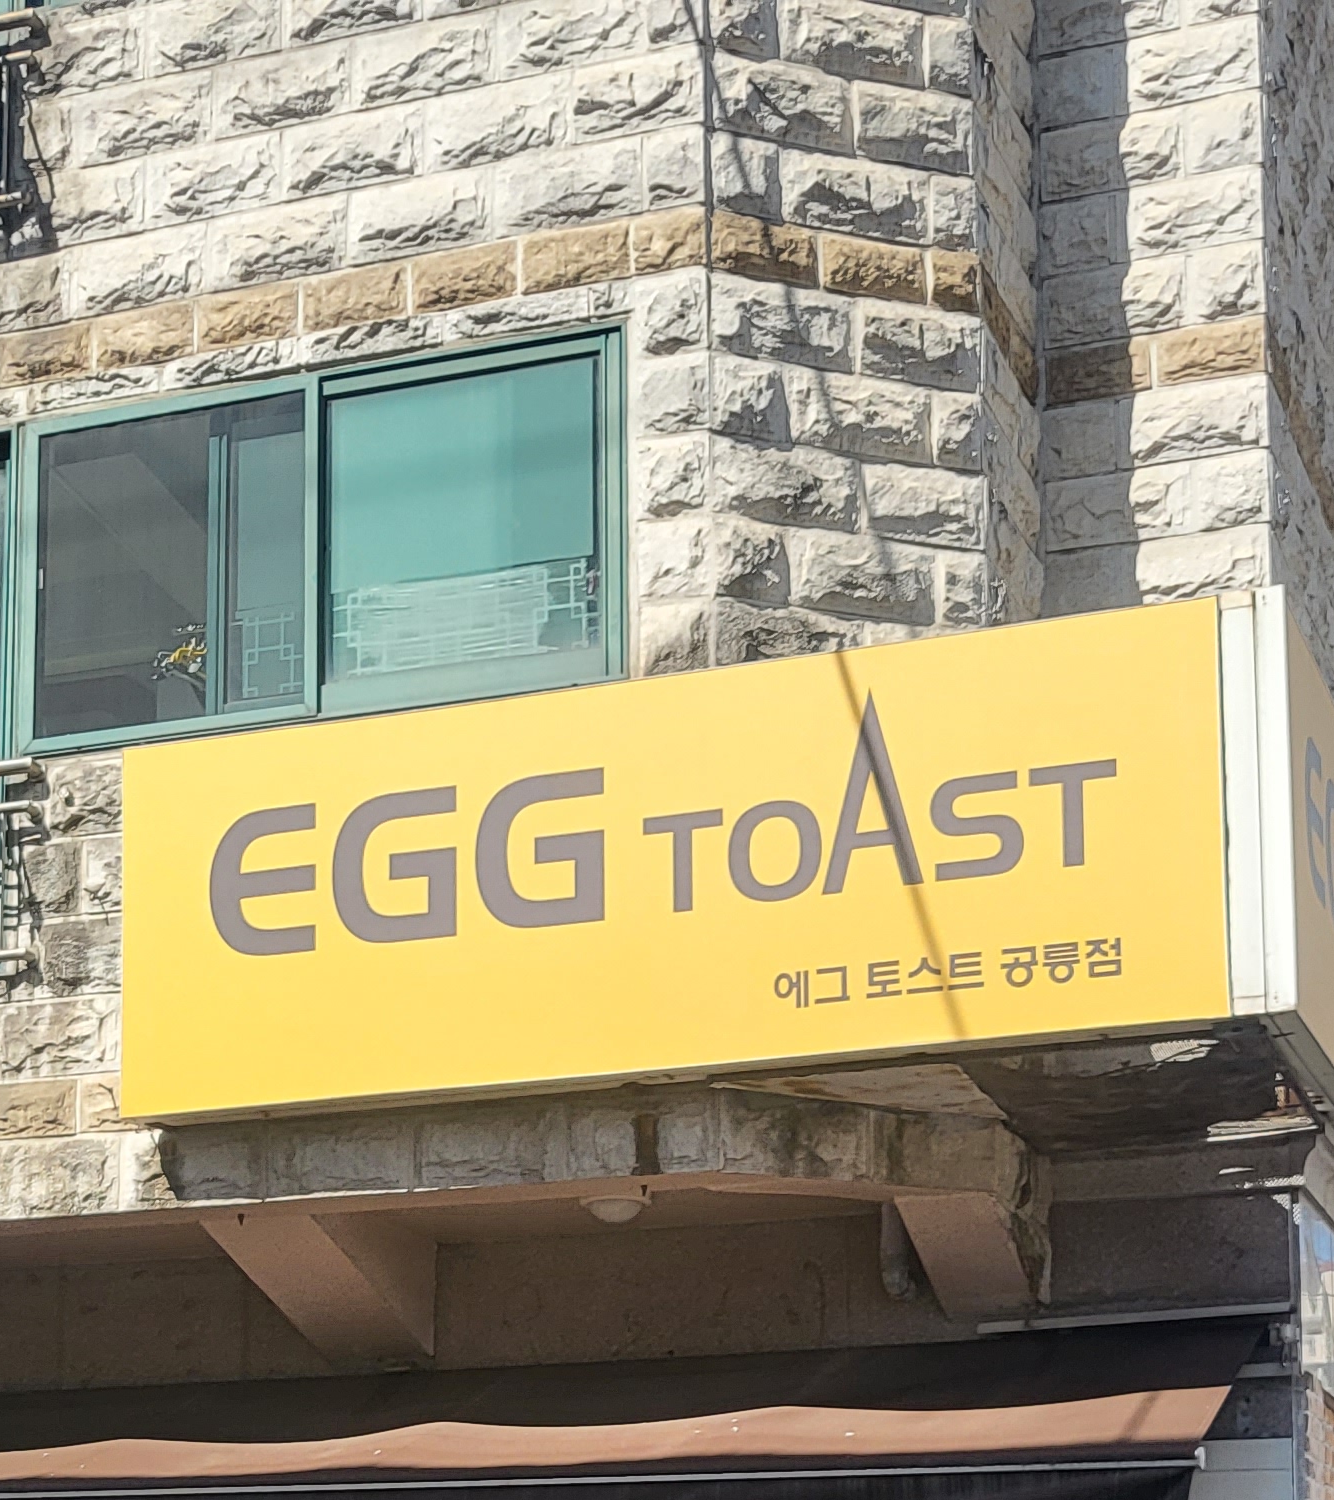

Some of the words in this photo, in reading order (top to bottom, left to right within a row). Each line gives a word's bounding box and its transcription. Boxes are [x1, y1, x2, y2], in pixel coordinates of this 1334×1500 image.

[210, 767, 605, 956] EGG
[643, 688, 1117, 912] TOAST
[774, 969, 850, 1008] 에그
[866, 951, 984, 999] 토스트
[1001, 938, 1122, 987] 공릉점
